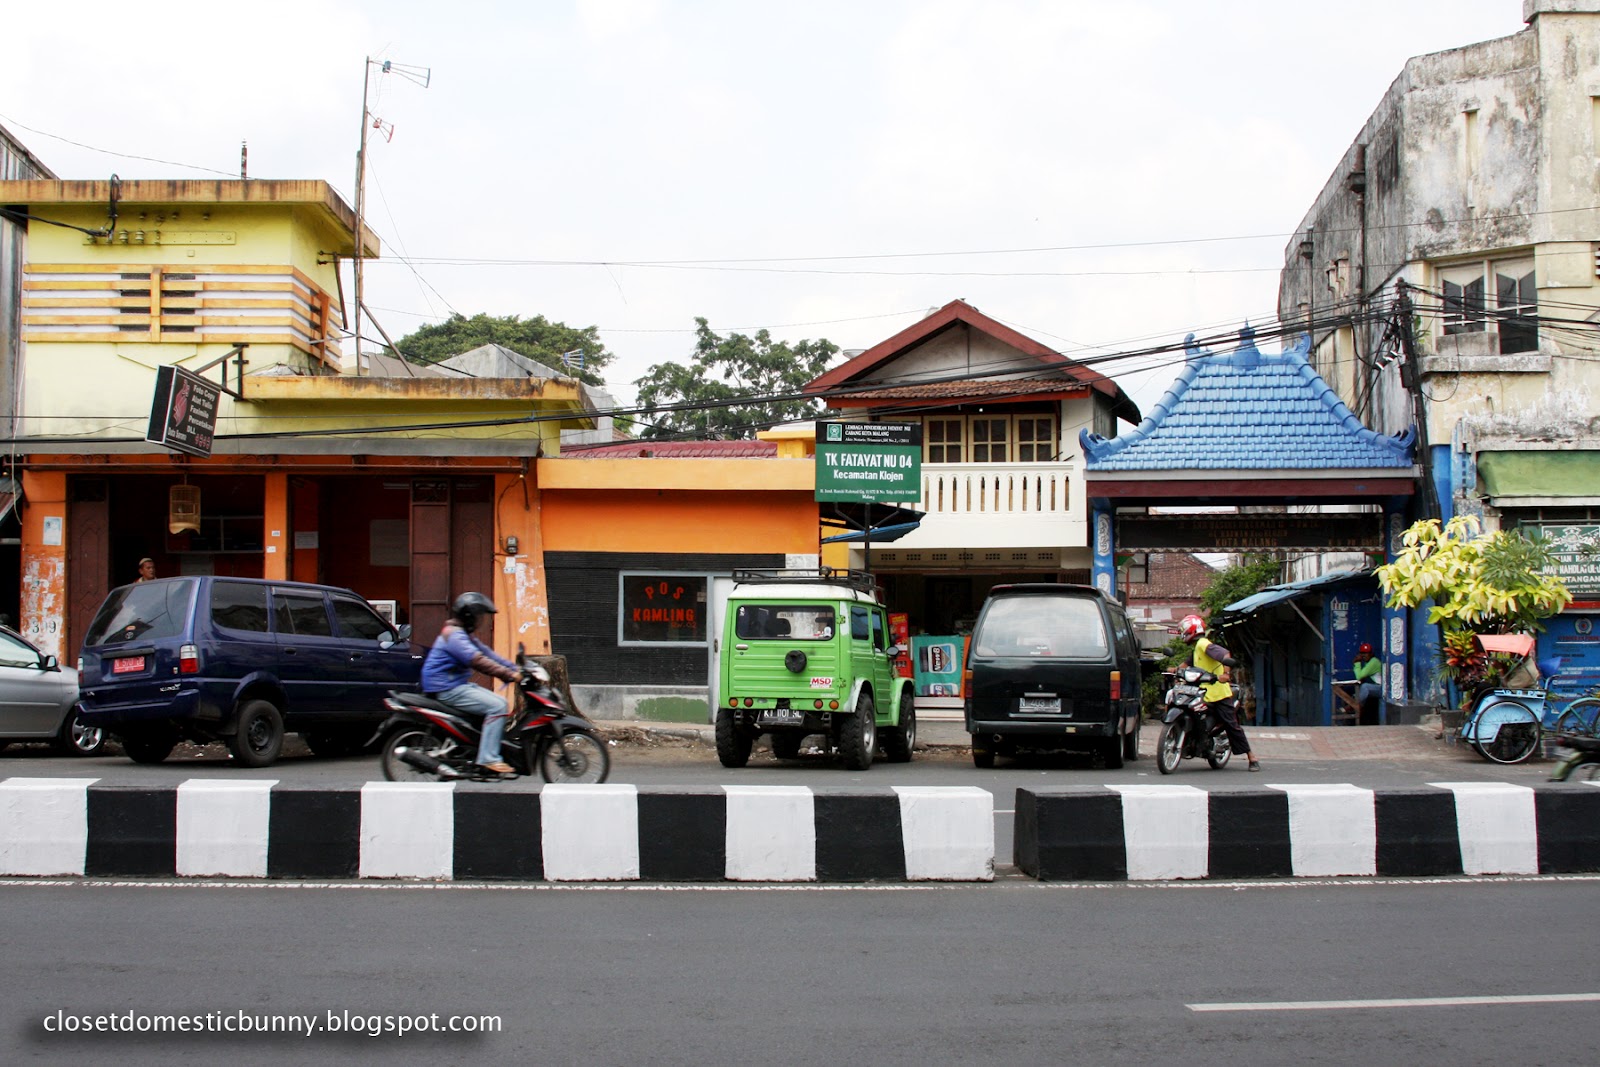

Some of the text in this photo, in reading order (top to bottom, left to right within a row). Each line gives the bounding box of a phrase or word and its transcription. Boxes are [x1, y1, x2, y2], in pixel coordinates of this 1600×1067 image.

[204, 390, 215, 402] Copy
[825, 453, 912, 469] TK FATAYAT NU 04
[833, 469, 904, 482] Kecamatan Klojen
[645, 582, 684, 599] POS
[633, 608, 695, 622] KAMLING
[811, 677, 832, 685] MSD
